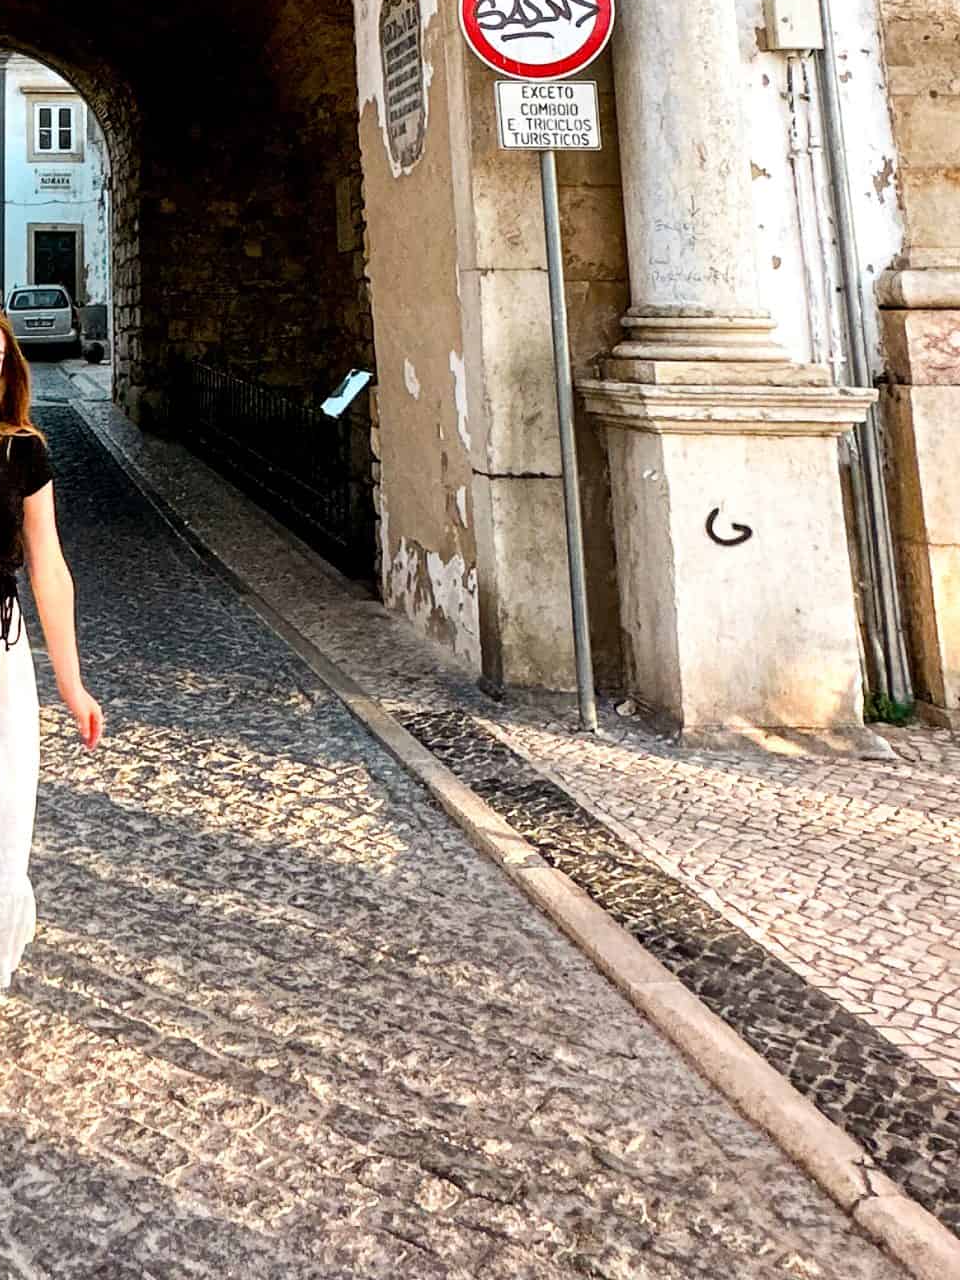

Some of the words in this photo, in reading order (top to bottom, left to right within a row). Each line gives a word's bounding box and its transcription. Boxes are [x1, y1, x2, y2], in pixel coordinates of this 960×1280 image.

[521, 85, 574, 99] EXCETO
[520, 103, 579, 116] COMBOIO
[507, 118, 516, 131] E
[525, 118, 592, 131] TRICICLOS
